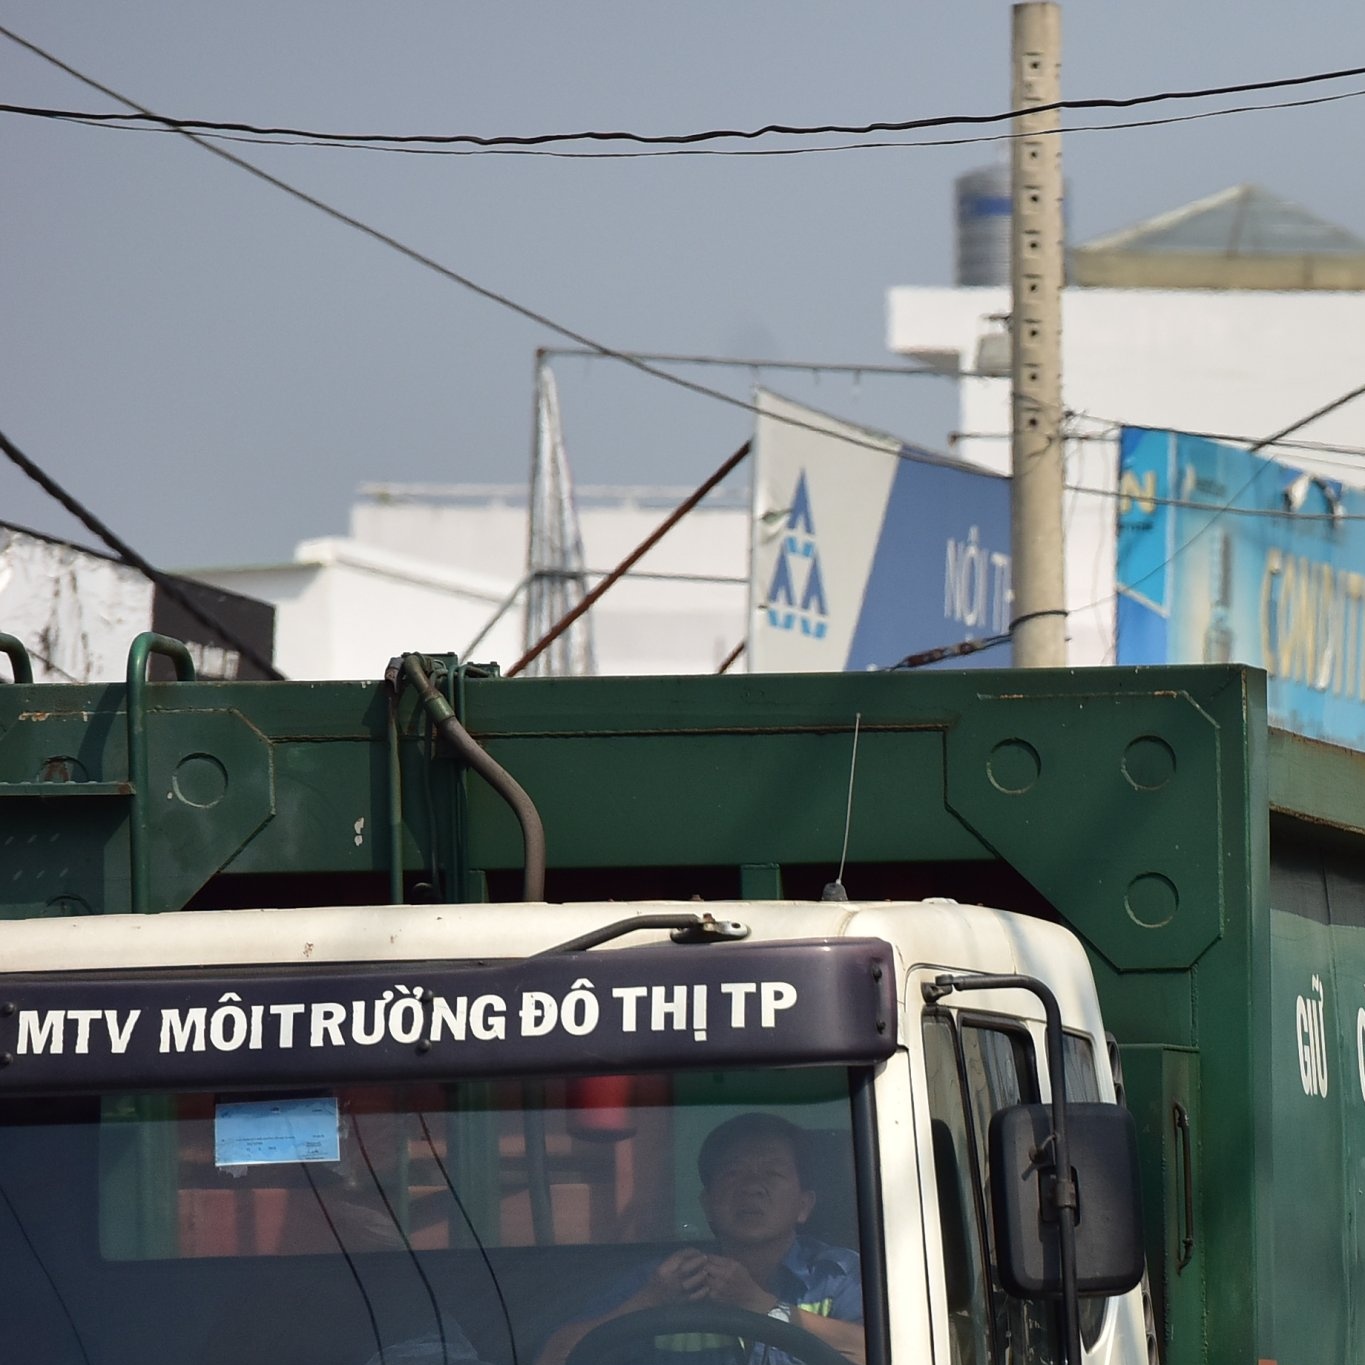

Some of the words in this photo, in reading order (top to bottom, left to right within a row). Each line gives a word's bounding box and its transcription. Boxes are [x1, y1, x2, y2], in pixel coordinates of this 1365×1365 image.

[15, 1008, 139, 1056] MTV
[159, 991, 264, 1053] MÔI
[270, 985, 507, 1051] TRƯỜNG
[518, 979, 600, 1036] ĐÔ
[612, 984, 708, 1043] THỊ
[721, 981, 799, 1030] TP
[1295, 973, 1328, 1099] GIỮ
